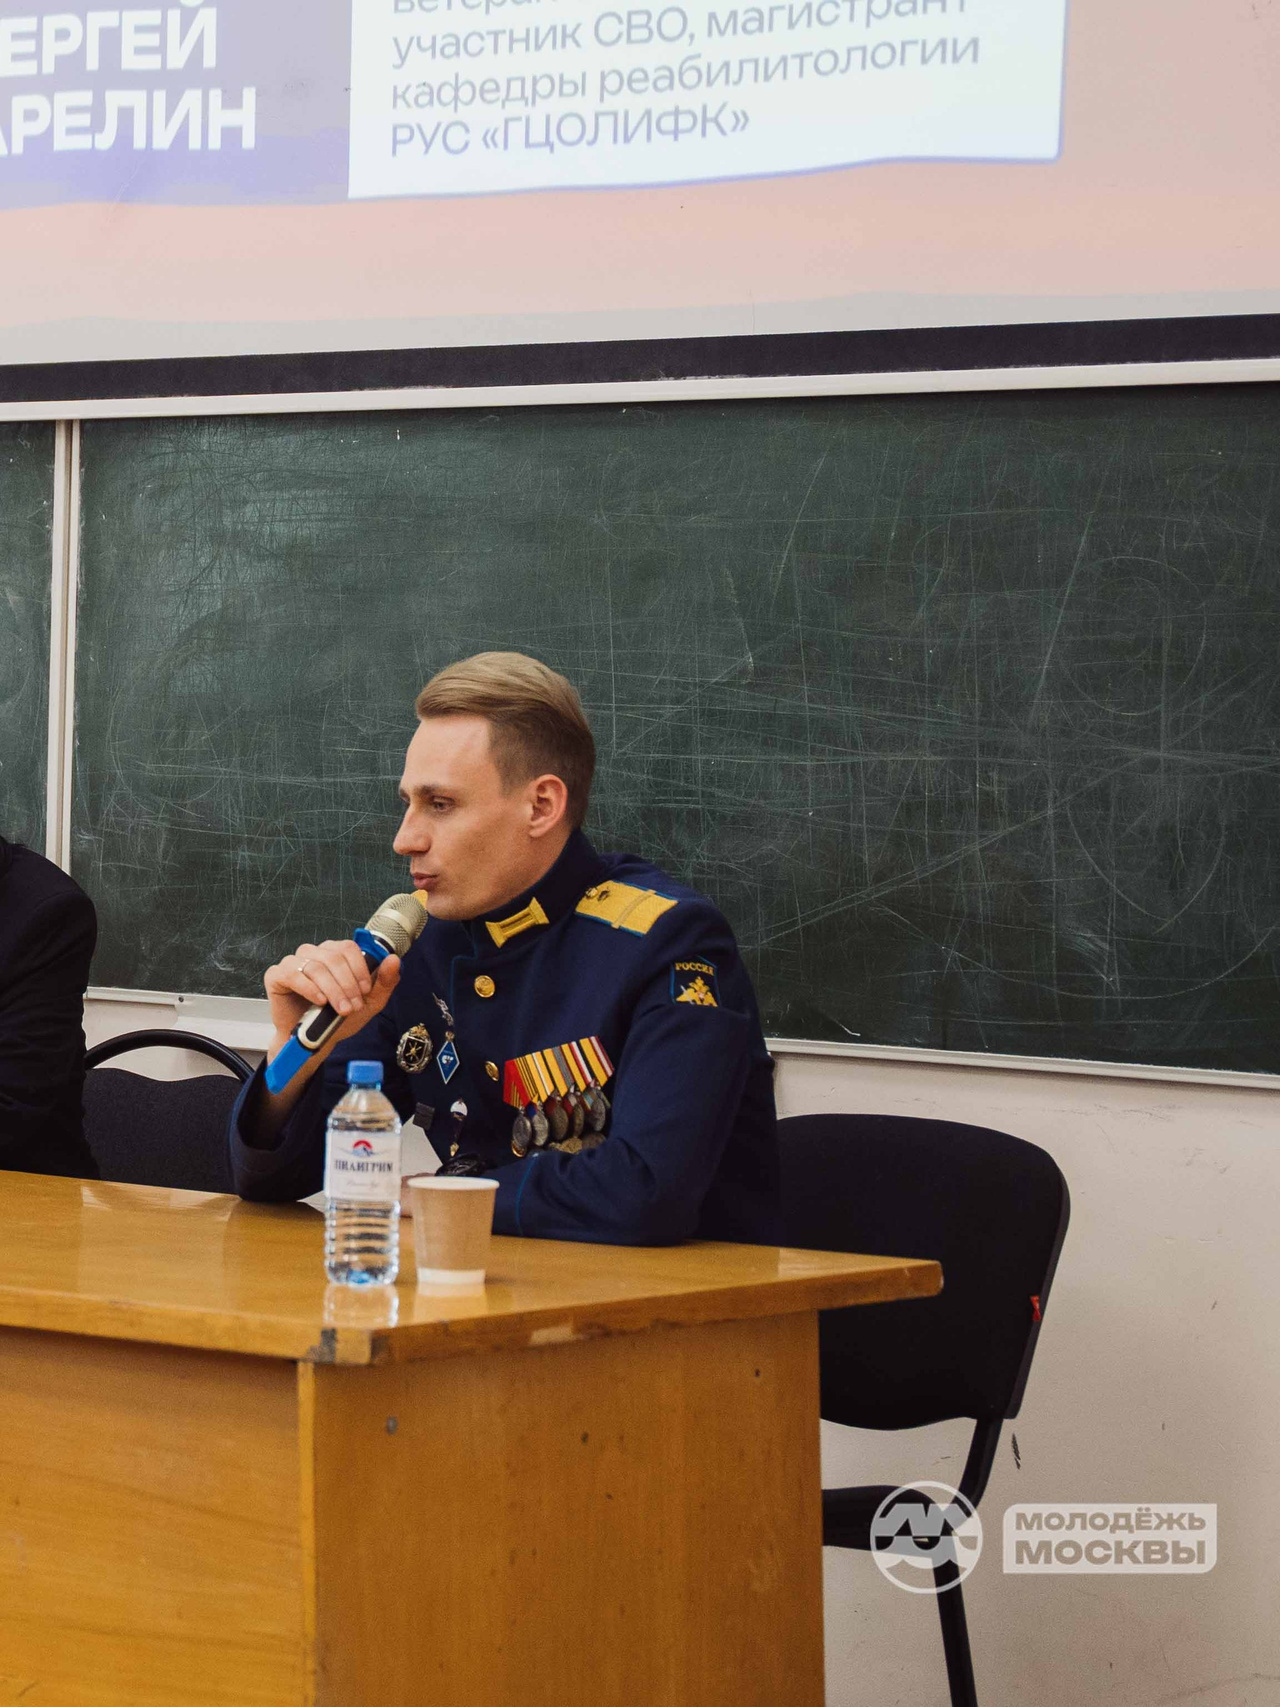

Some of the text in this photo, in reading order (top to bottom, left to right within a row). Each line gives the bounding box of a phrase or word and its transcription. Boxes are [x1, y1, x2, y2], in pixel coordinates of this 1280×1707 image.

[392, 22, 582, 69] участник
[594, 6, 696, 47] СВО,
[392, 37, 979, 113] кафедры реабилитологии
[392, 101, 750, 157] РУС «ГЦОЛИФК»
